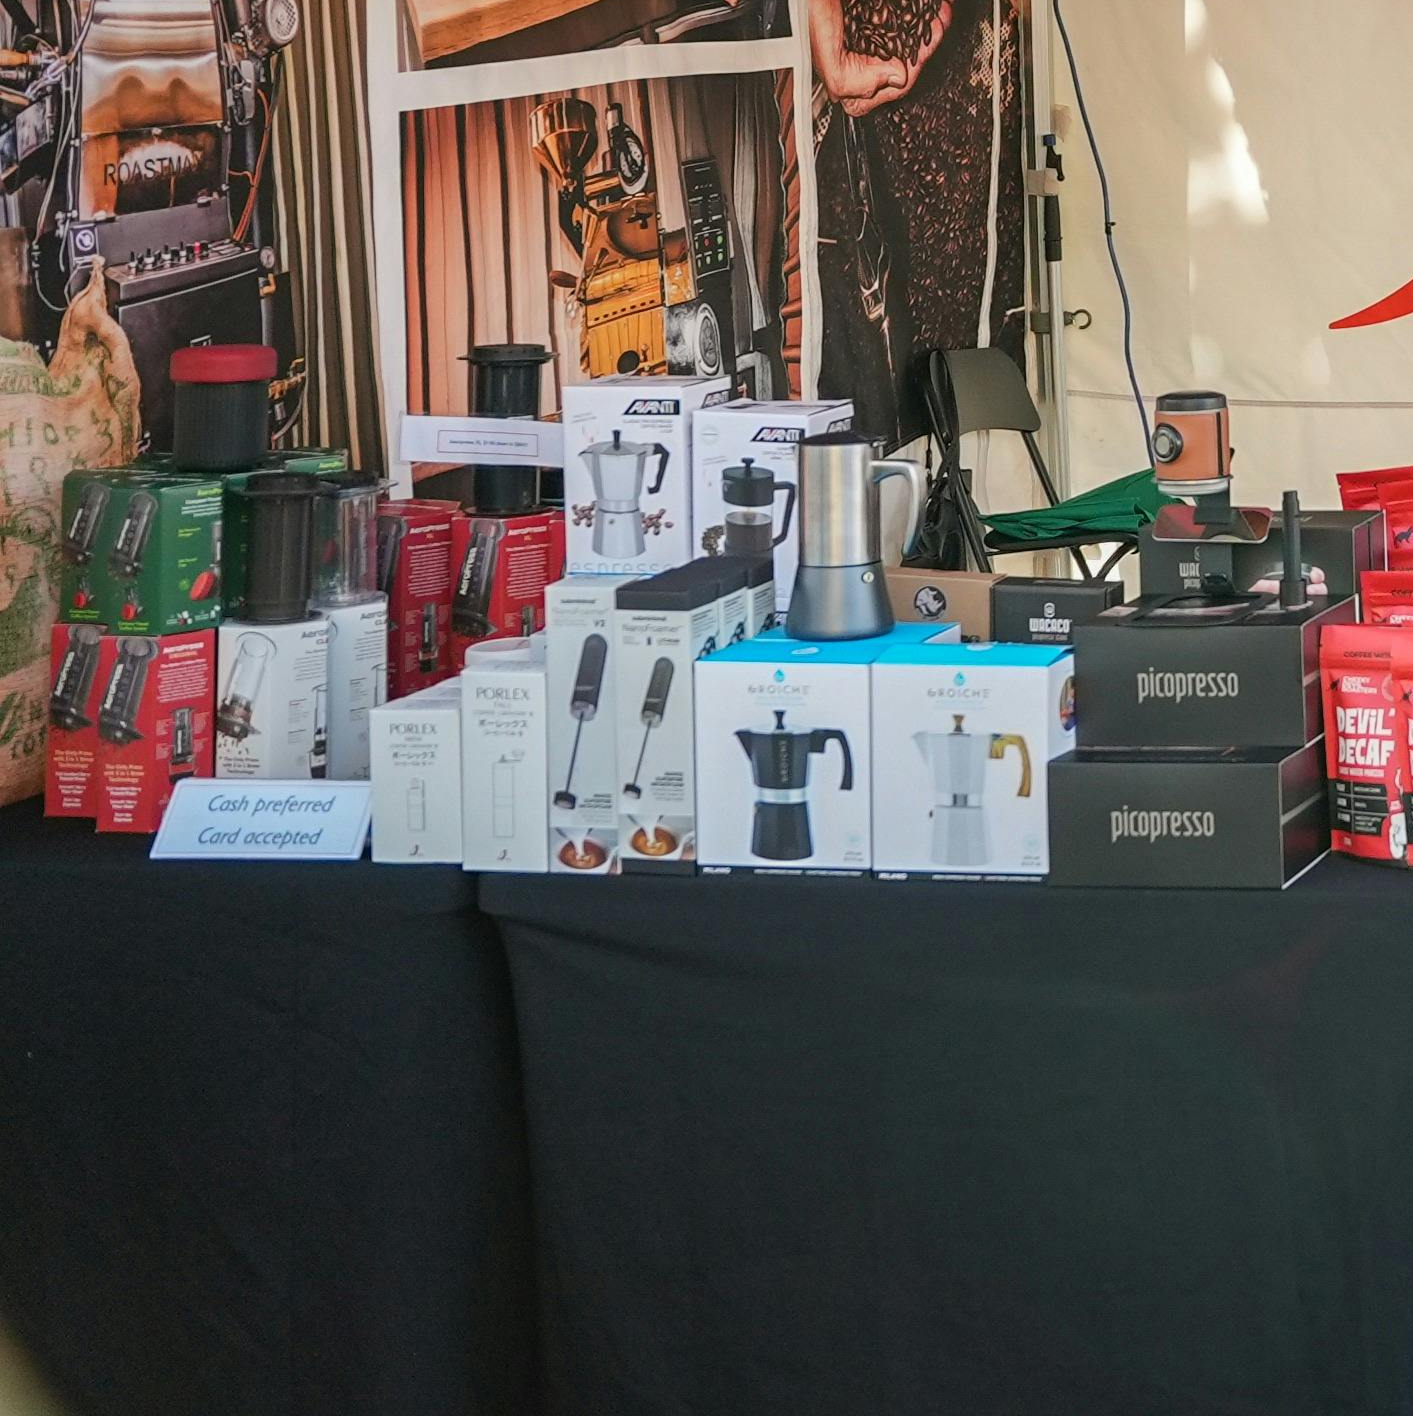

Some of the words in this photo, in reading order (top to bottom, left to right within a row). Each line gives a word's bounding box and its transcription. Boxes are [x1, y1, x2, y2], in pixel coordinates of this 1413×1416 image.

[627, 400, 677, 415] AVANTI
[506, 525, 546, 537] AeroPress
[1029, 617, 1070, 634] WACACO
[475, 686, 531, 701] PORLEX
[1136, 666, 1239, 704] picopresso
[388, 723, 439, 736] PORLEX
[1337, 738, 1396, 767] DECAF
[208, 793, 249, 814] Cash
[252, 793, 337, 819] preferred
[1110, 805, 1216, 843] picopresso
[198, 826, 240, 847] Card
[244, 826, 323, 853] accepted
